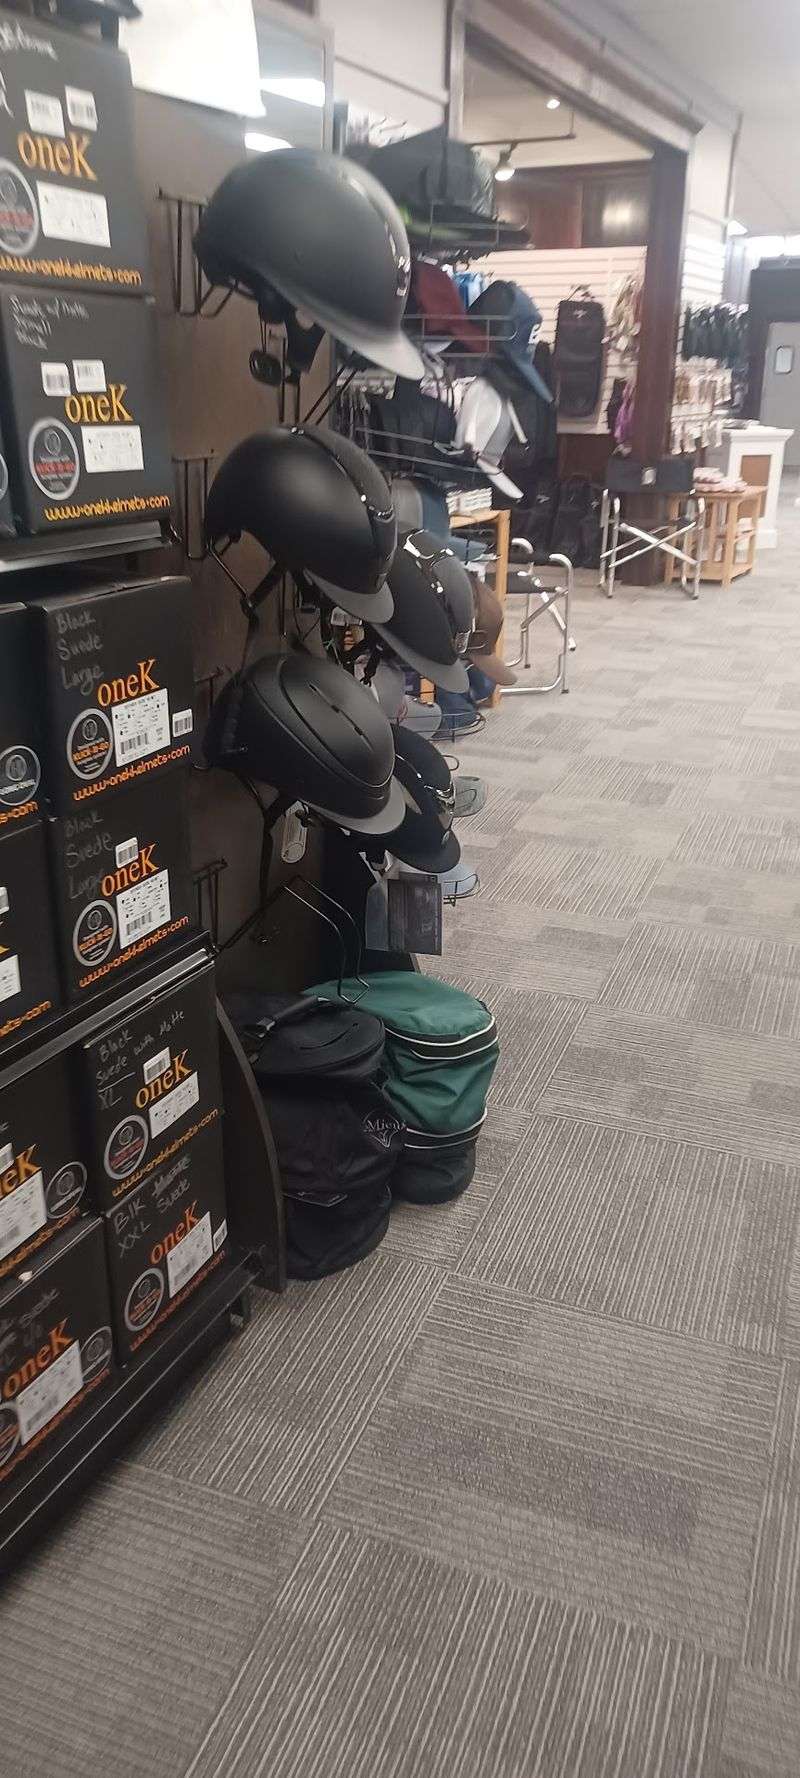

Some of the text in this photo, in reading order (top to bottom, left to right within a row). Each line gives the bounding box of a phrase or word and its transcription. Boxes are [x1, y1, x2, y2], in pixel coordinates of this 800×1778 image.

[18, 131, 98, 181] oneK
[65, 383, 134, 423] oneK
[56, 609, 96, 634] Black
[56, 634, 104, 661] Suede
[97, 658, 160, 707] oneK
[101, 843, 160, 897] oneK
[135, 1048, 193, 1108] oneK
[150, 1199, 201, 1265] oneK
[3, 1317, 73, 1399] oneK
